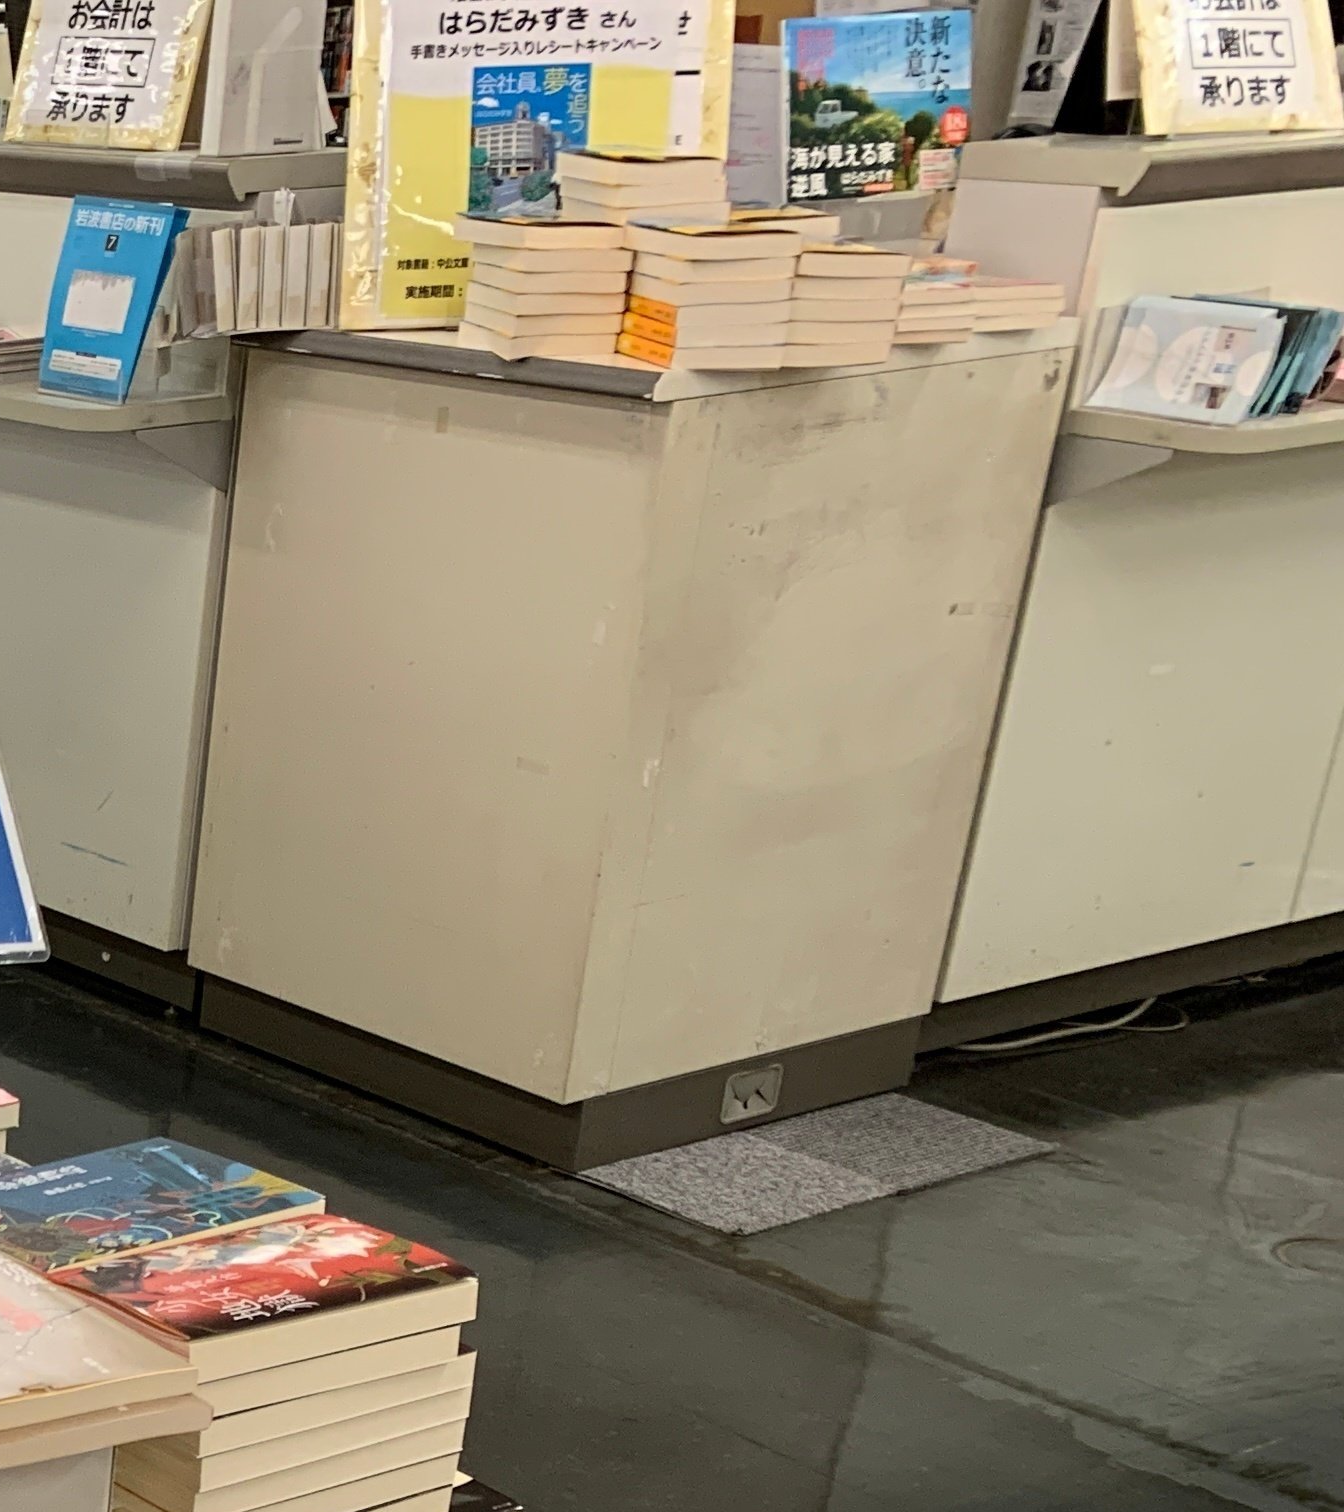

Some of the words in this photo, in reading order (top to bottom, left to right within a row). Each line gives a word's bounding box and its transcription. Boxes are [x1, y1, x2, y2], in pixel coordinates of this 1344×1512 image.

[439, 7, 590, 35] はらだみずき
[600, 11, 637, 29] さん
[411, 37, 662, 60] 手書きメッセージ入りレシートキャンペーン
[905, 17, 926, 88] 決意。
[930, 16, 952, 104] 新たな
[1199, 75, 1292, 107] 承ります
[47, 91, 135, 123] 承ります
[790, 142, 896, 170] 海が見える家
[790, 172, 827, 198] 逆風
[75, 208, 165, 236] 岩波書店の新刊
